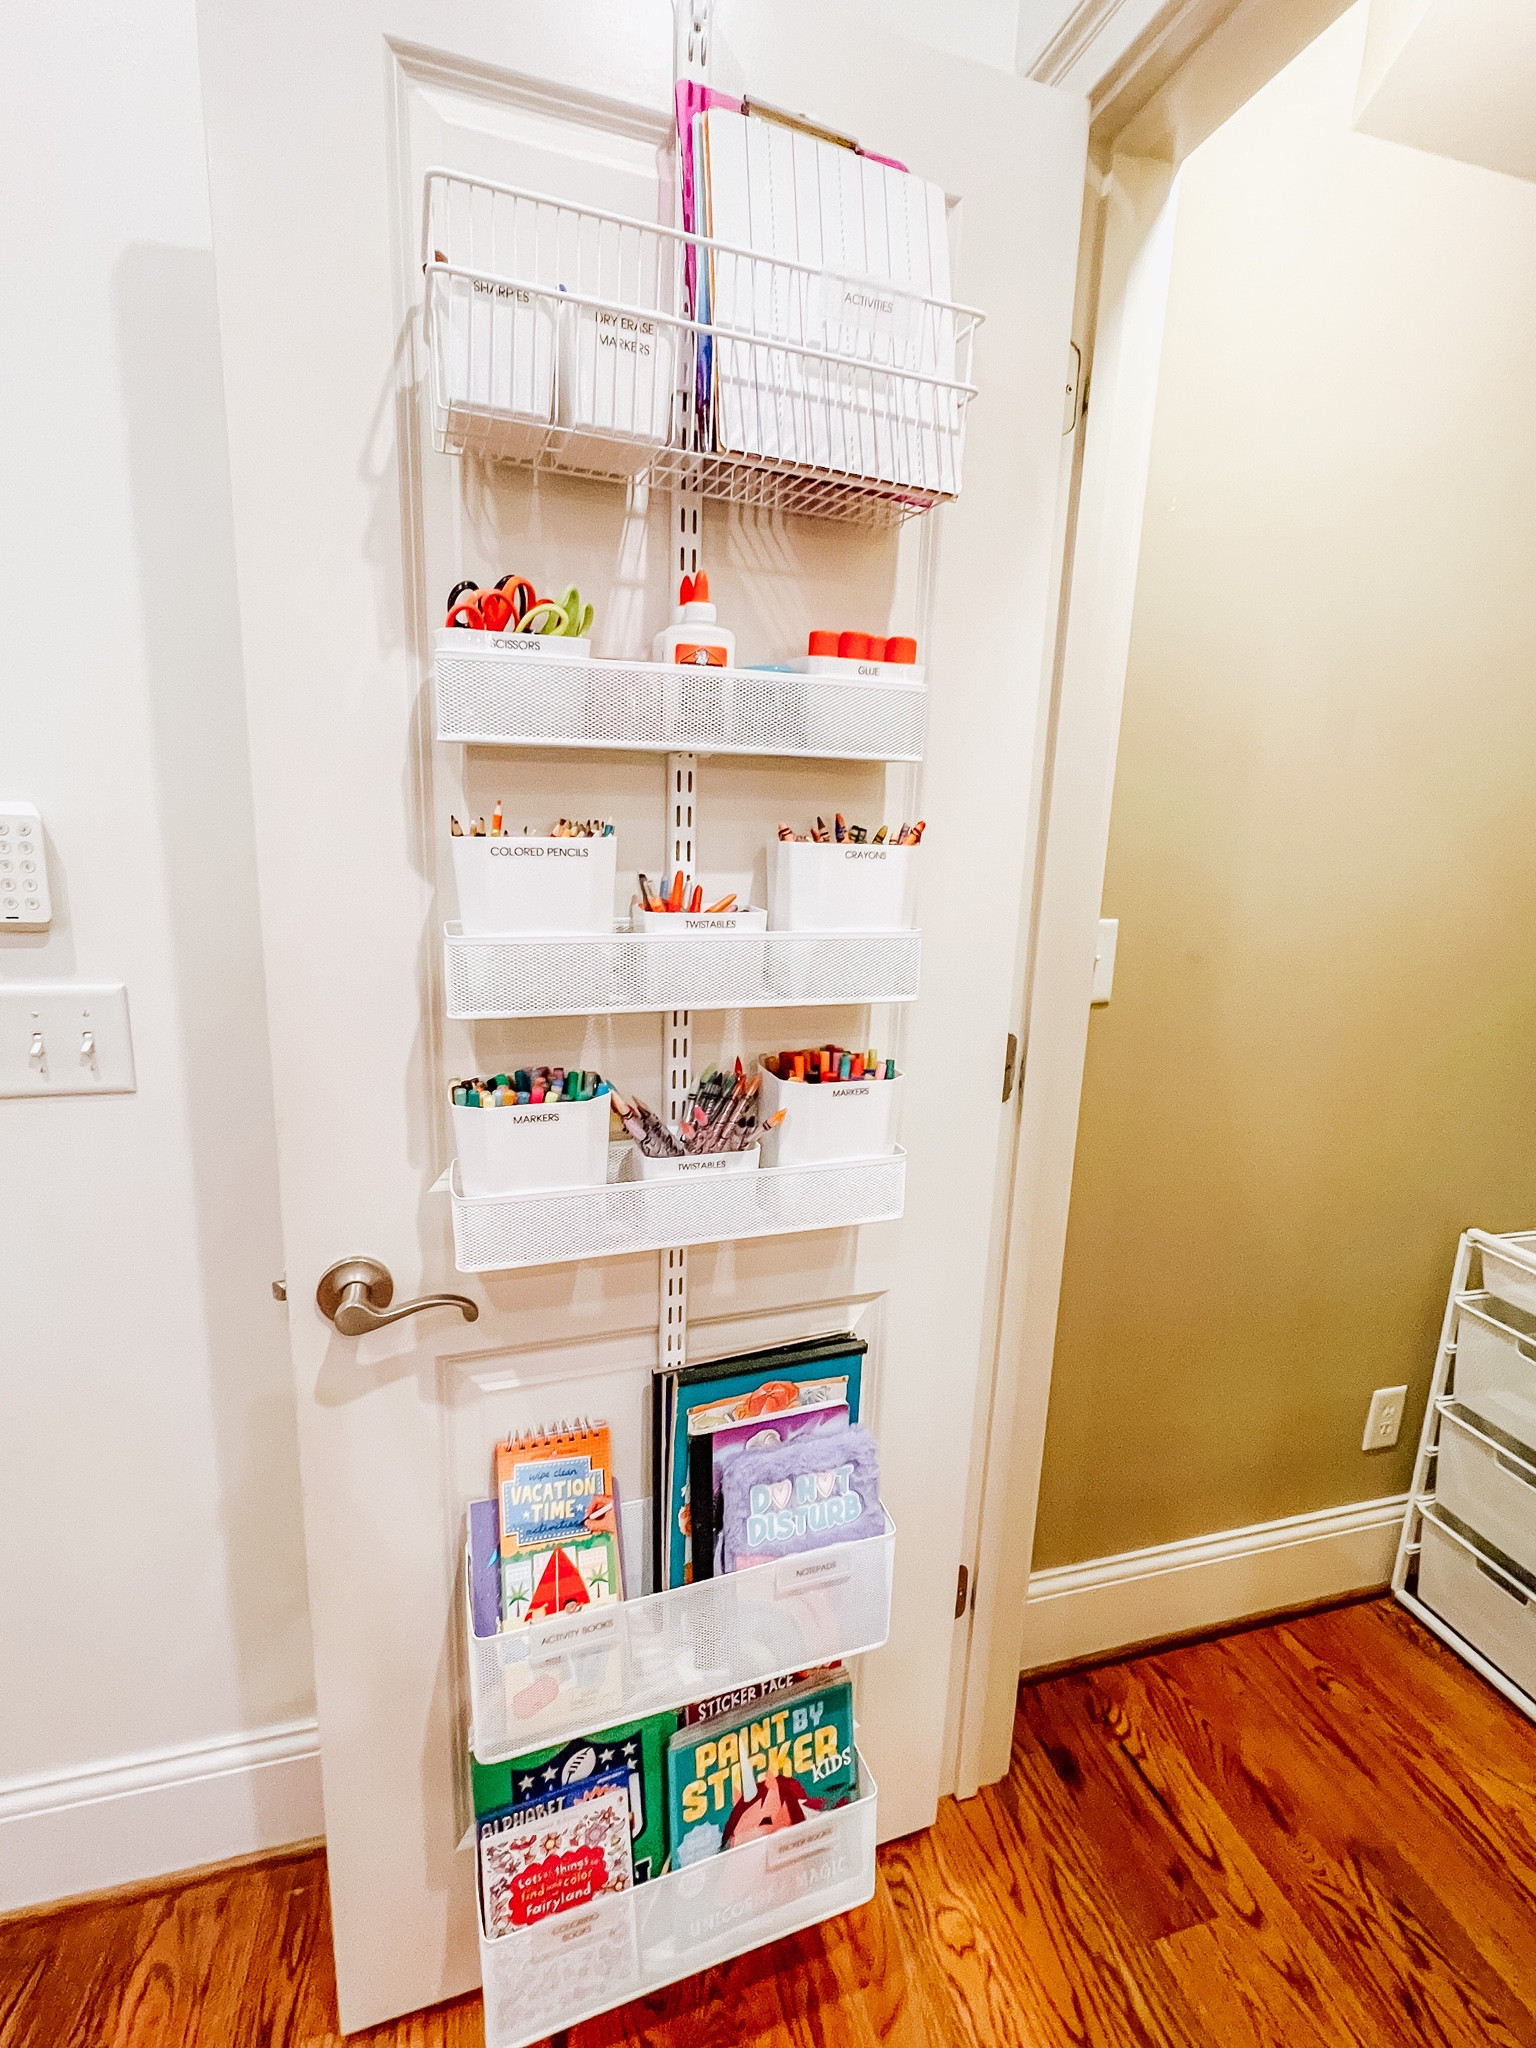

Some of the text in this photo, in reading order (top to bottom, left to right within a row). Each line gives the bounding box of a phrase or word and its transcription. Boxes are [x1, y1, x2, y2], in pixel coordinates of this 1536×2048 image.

[844, 292, 893, 314] ACTIVITIES
[599, 332, 650, 356] MARKERS
[490, 638, 541, 652] SCISSORS
[857, 665, 879, 677] GLUE
[490, 846, 590, 858] COLORED PENCILS
[845, 850, 887, 860] CRAYONS
[685, 920, 737, 929] TWISTABLES
[832, 1087, 870, 1098] MARKERS
[513, 1113, 560, 1125] MARKERS
[678, 1160, 727, 1171] TWISTABLES
[553, 1466, 578, 1478] clean
[510, 1476, 597, 1507] VACATION
[530, 1500, 576, 1524] TIME
[746, 1489, 863, 1547] DISTURB
[541, 1618, 614, 1646] ACTIVITY BOOKS
[697, 1674, 795, 1722] STICKER FACE
[791, 1700, 825, 1735] BY
[810, 1746, 852, 1784] KIDS
[517, 1871, 543, 1890] Lots
[555, 1856, 590, 1876] things
[521, 1881, 546, 1904] find
[563, 1868, 594, 1888] color
